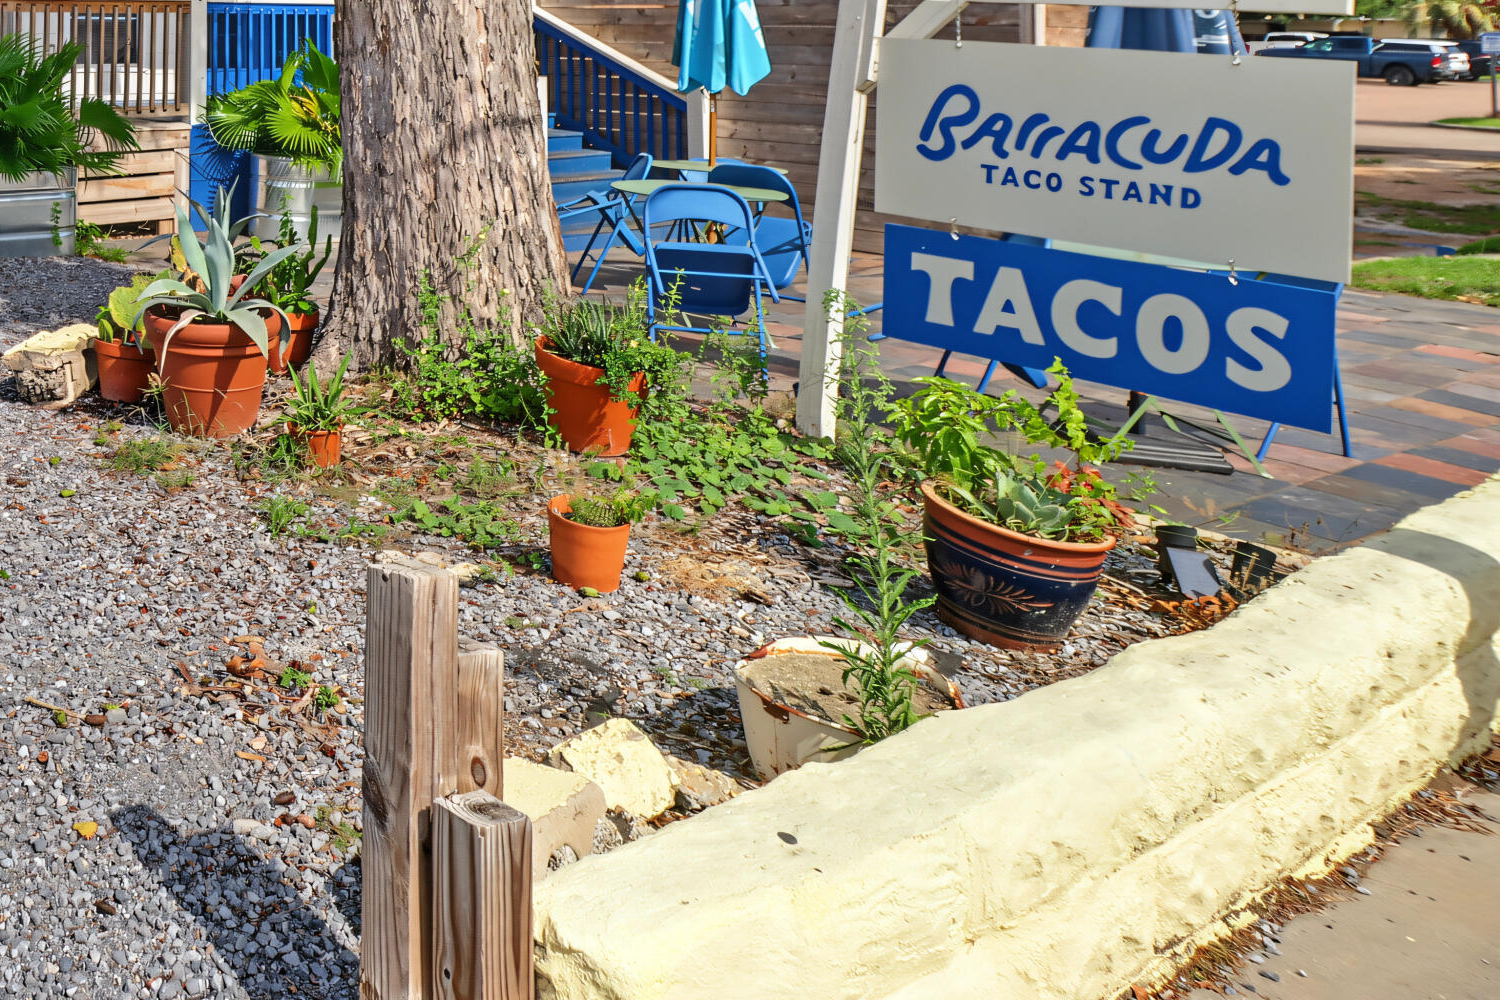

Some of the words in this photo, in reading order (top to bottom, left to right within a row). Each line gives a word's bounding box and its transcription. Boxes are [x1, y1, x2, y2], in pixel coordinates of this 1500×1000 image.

[980, 163, 1063, 193] TACO
[1079, 175, 1202, 210] STAND
[911, 252, 1292, 392] TACOS
